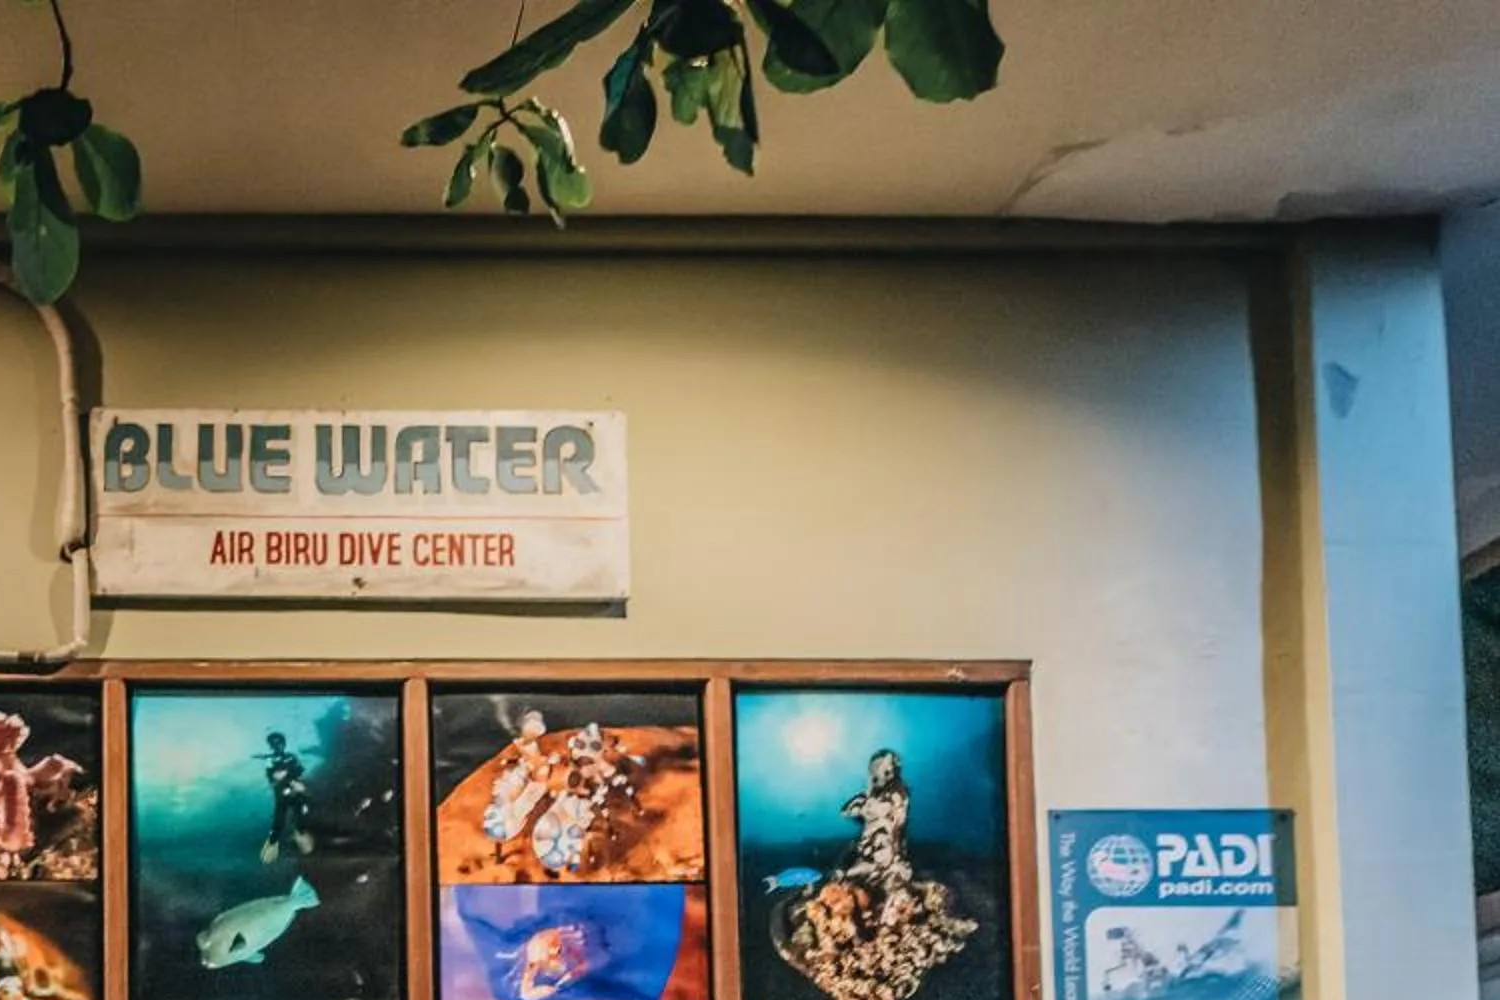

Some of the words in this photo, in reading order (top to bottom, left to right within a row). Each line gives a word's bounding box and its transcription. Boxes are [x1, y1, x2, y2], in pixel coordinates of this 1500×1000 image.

[103, 422, 291, 494] BLUE
[314, 424, 601, 496] WATER
[210, 531, 255, 566] AIR
[265, 531, 328, 566] BIRU
[338, 532, 401, 566] DIVE
[413, 533, 515, 567] CENTER
[1059, 832, 1076, 857] The
[1155, 833, 1276, 877] PADI
[1057, 860, 1077, 895] Way
[1158, 878, 1275, 899] padi.com
[1061, 900, 1078, 923] the
[1062, 926, 1081, 973] World
